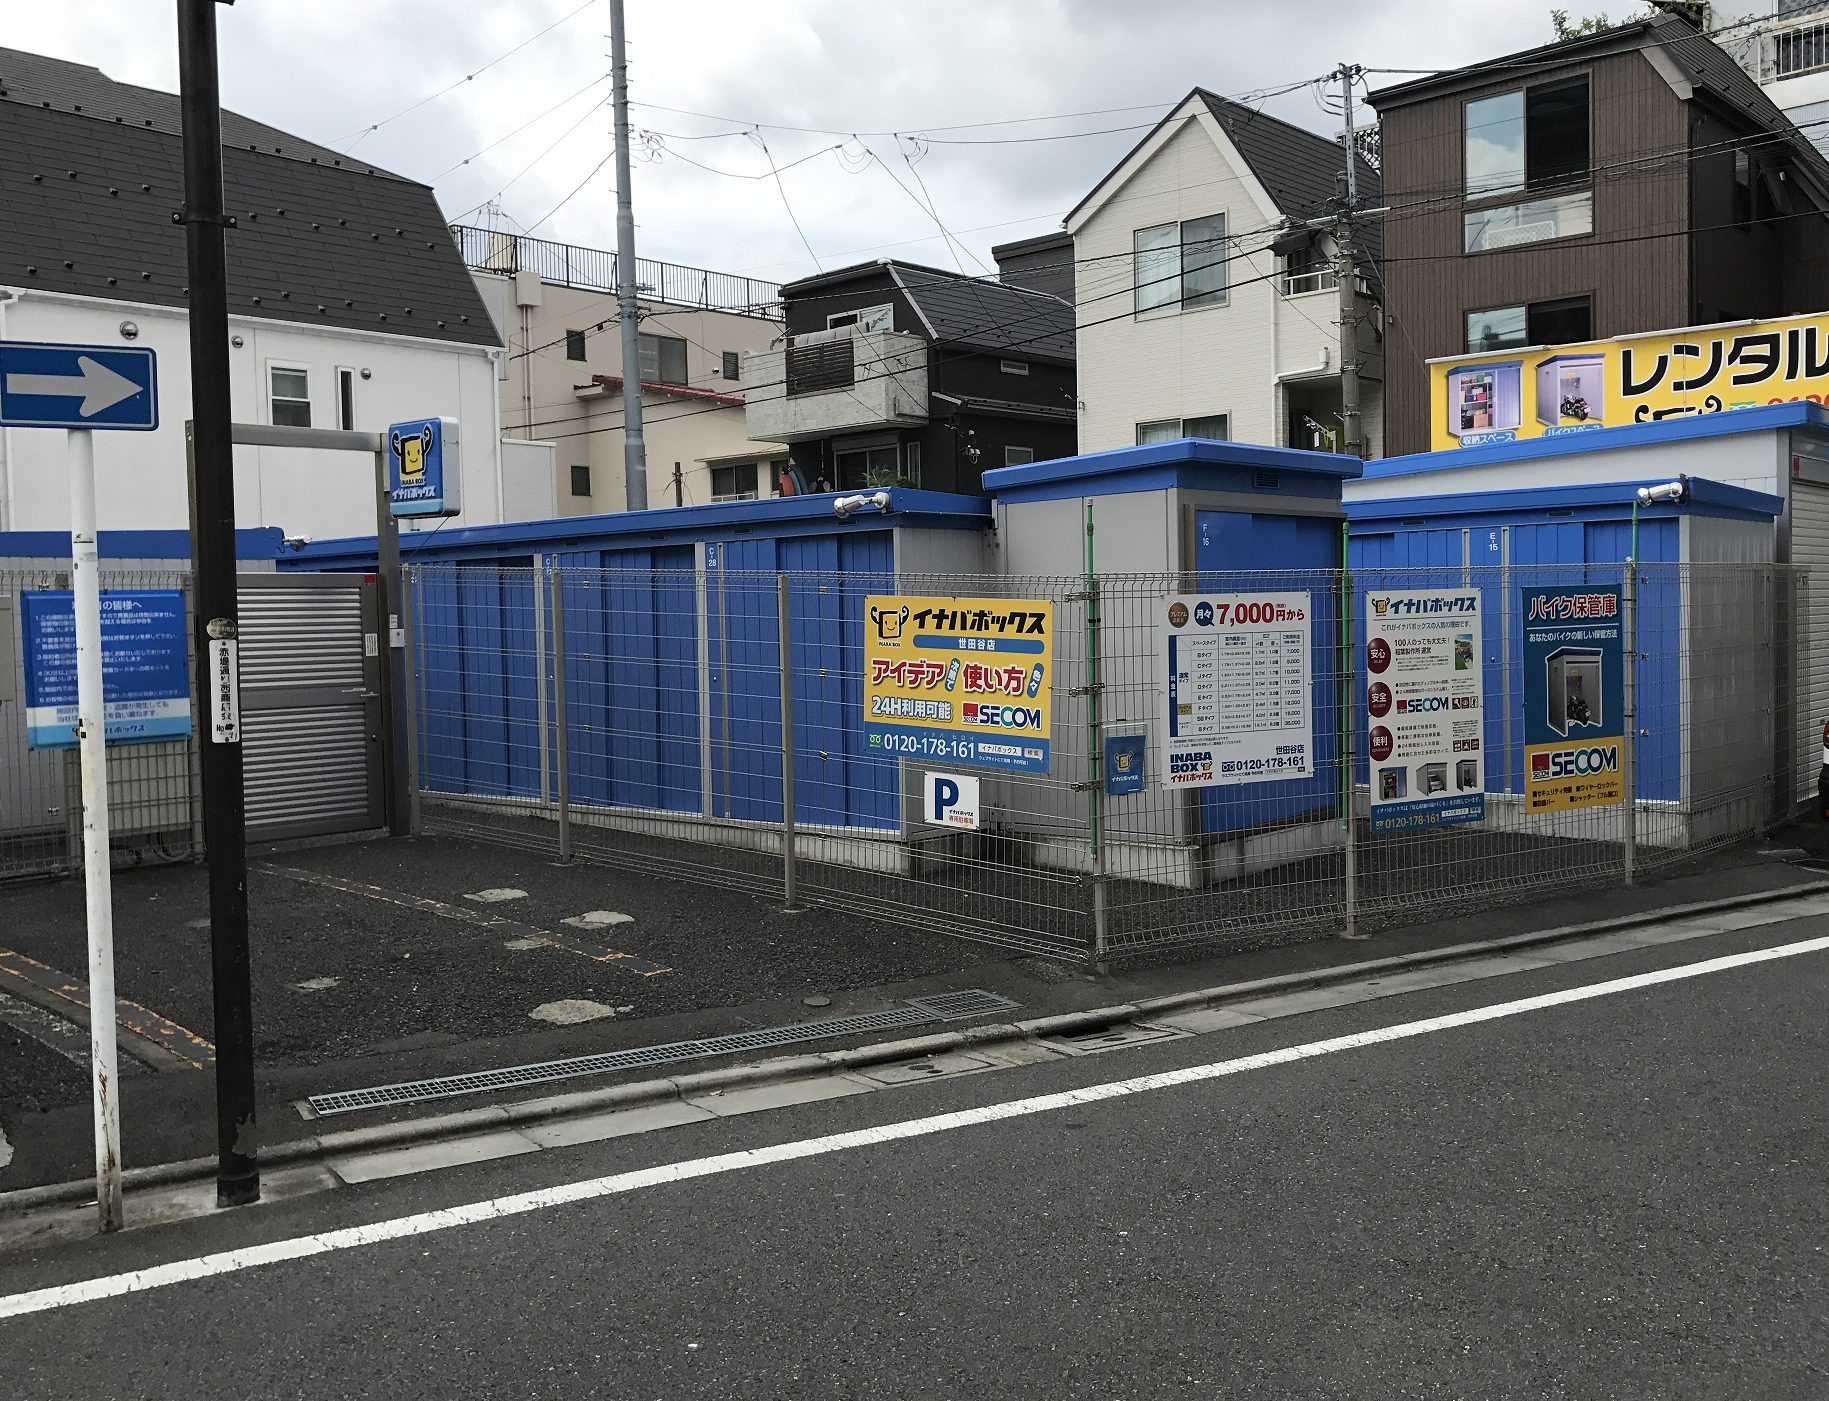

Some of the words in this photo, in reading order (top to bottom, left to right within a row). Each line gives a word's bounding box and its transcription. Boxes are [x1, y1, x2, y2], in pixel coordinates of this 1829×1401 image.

[1622, 326, 1829, 396] レンタル
[1463, 432, 1514, 446] 収納スペース
[392, 485, 436, 500] イナバボックス
[1390, 597, 1477, 614] イナバボックス
[1529, 594, 1617, 620] バイク保管庫
[913, 608, 1046, 635] イナバボックス
[1195, 609, 1212, 619] 月々
[1529, 629, 1618, 642] あなたのバイクの新しい保管方法
[958, 638, 996, 651] 世田谷店
[1370, 648, 1386, 659] 安心
[872, 659, 944, 686] アイデア
[946, 660, 960, 690] 次第で
[962, 663, 1025, 693] 使い方
[1029, 670, 1042, 691] 色々
[1371, 692, 1387, 703] 安全
[1408, 696, 1449, 713] SECOM
[872, 695, 952, 721] 24H利用可能
[979, 705, 1041, 729] SECOM
[884, 733, 975, 759] 0120-178-161
[1372, 735, 1388, 747] 便利
[981, 744, 1018, 756] イナバボックス
[1276, 744, 1305, 755] 世田谷店
[1170, 751, 1213, 764] INABA
[1236, 756, 1305, 771] 0120-178-161
[1551, 746, 1617, 777] SECOM
[1170, 763, 1199, 773] BOX
[1170, 772, 1213, 783] イナバボックス
[934, 777, 959, 821] P
[1385, 813, 1440, 829] 0120-178-161
